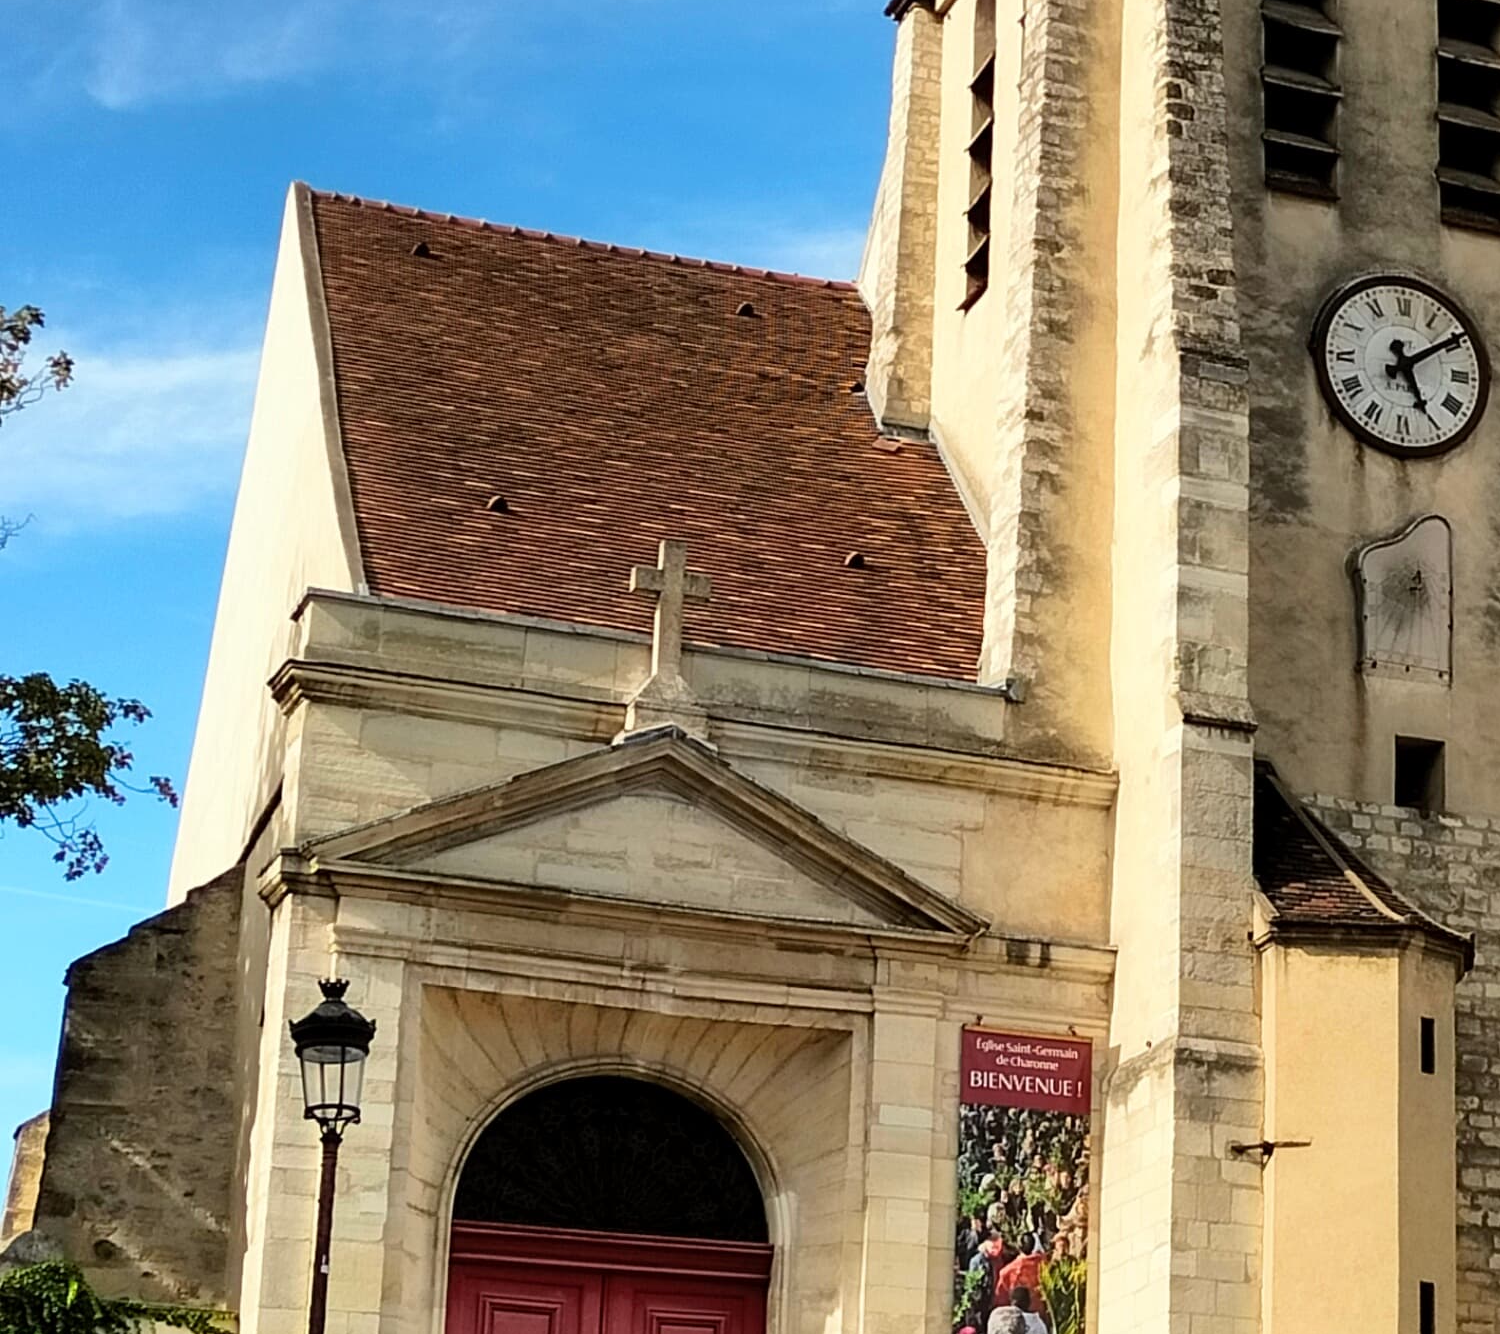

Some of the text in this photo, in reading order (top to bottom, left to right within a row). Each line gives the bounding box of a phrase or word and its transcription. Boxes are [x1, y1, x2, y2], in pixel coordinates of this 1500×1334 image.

[1450, 369, 1469, 385] III
[976, 1037, 1079, 1060] Église Saint-Germain
[995, 1053, 1059, 1071] de Charonne
[970, 1070, 1082, 1098] BIENVENUE !
